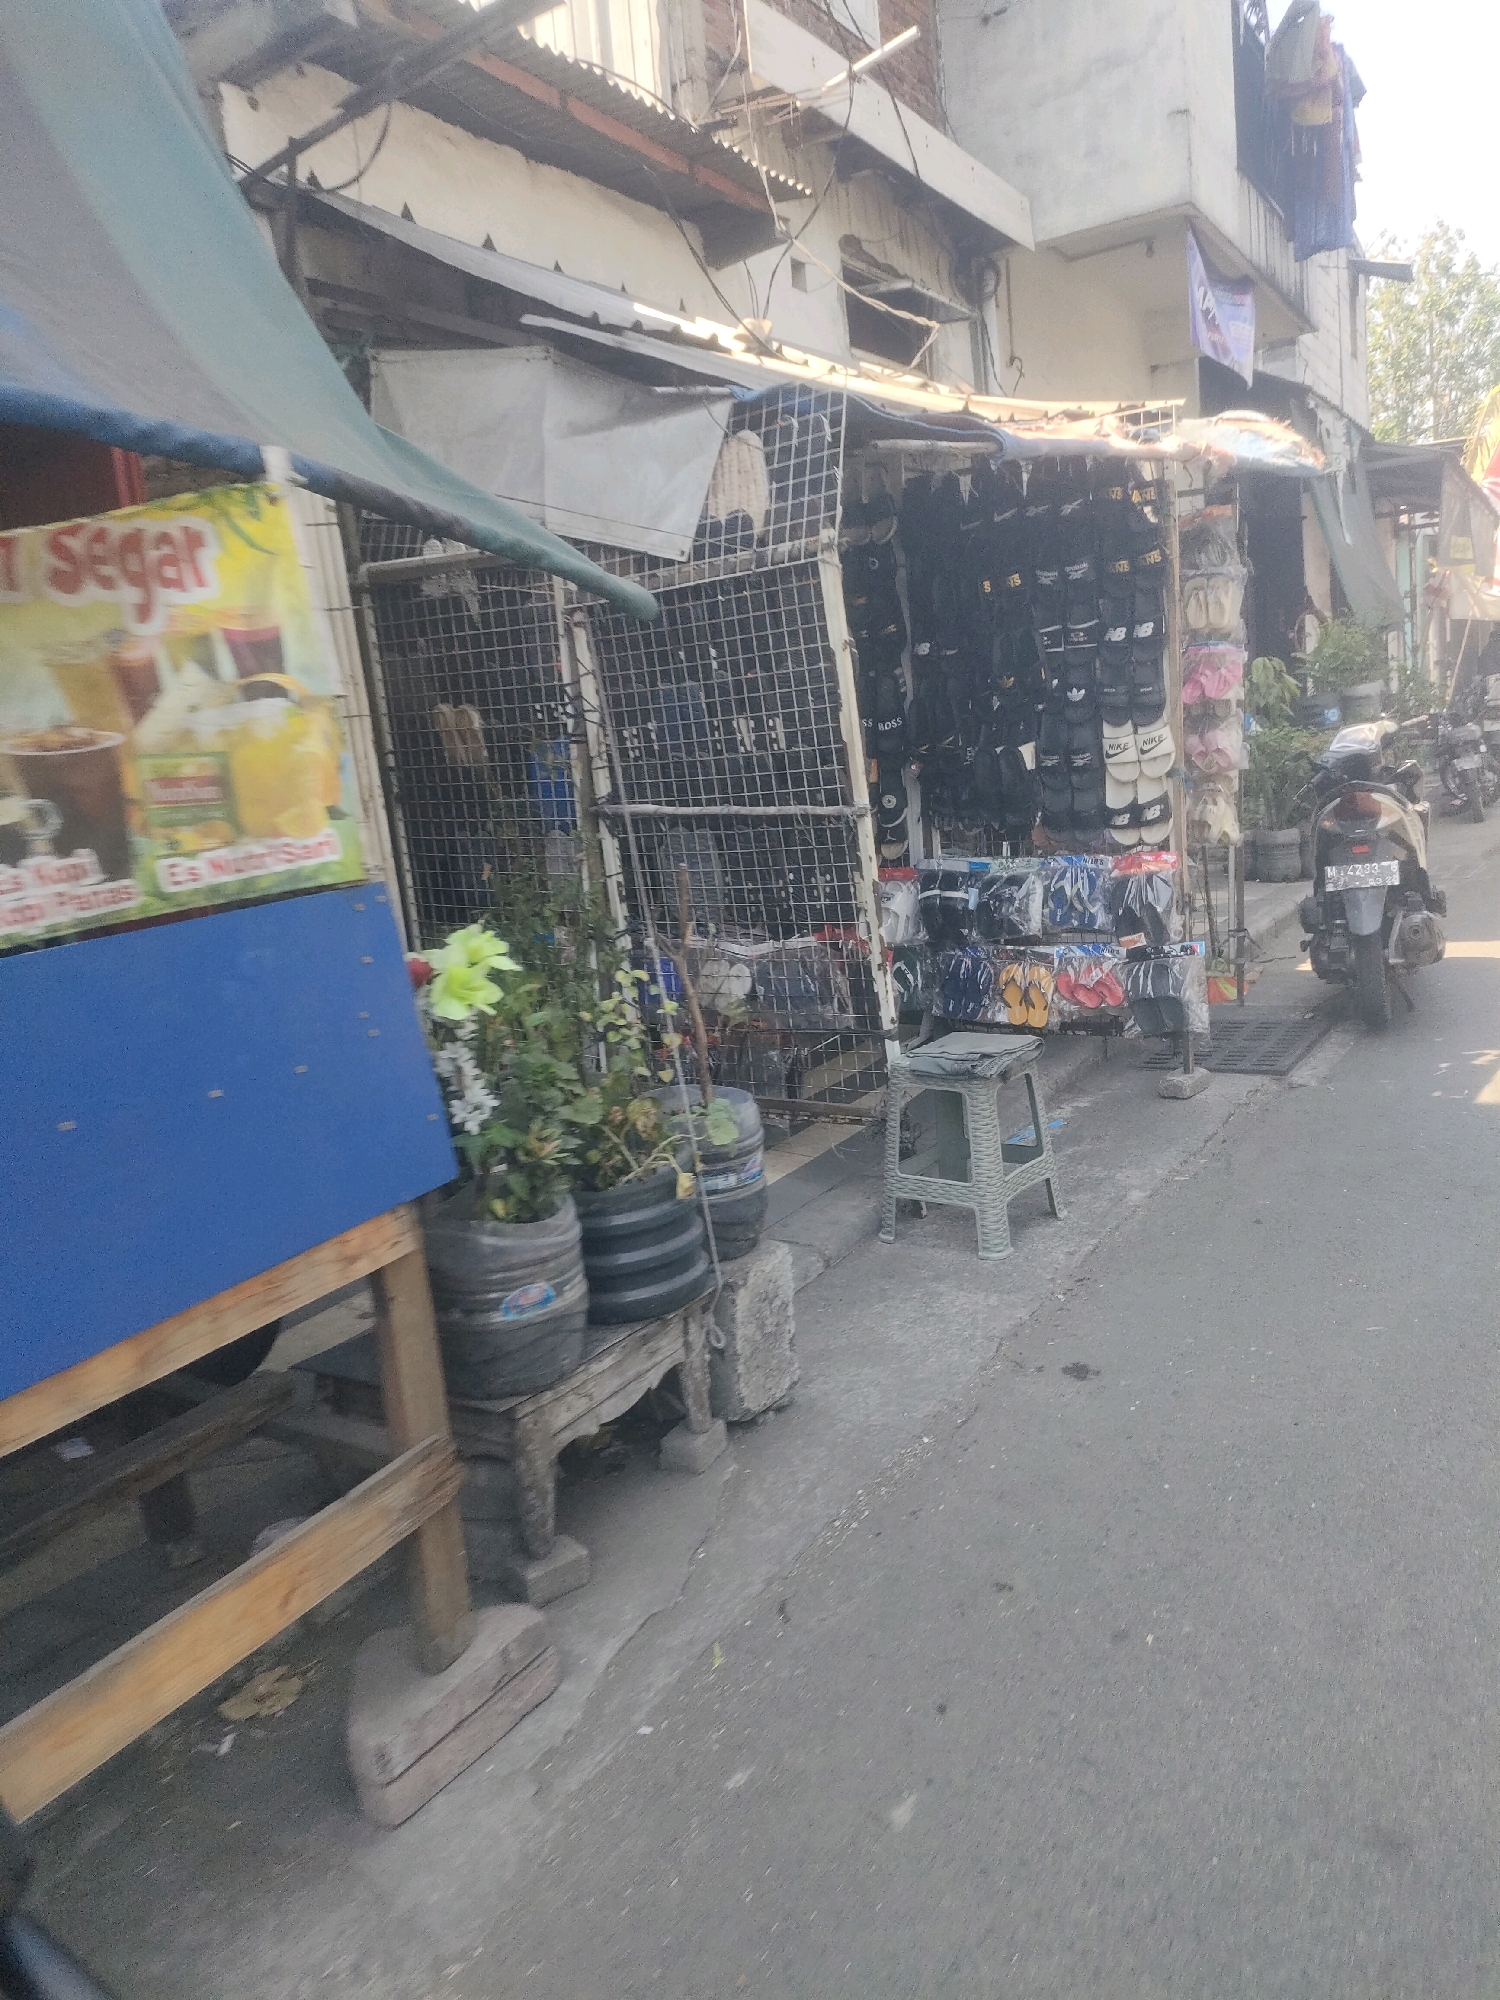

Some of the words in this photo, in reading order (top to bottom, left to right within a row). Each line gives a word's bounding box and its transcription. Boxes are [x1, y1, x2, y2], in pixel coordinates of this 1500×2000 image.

[878, 717, 903, 731] BOSS
[1108, 742, 1129, 751] NIKE
[1142, 734, 1164, 747] NIKE
